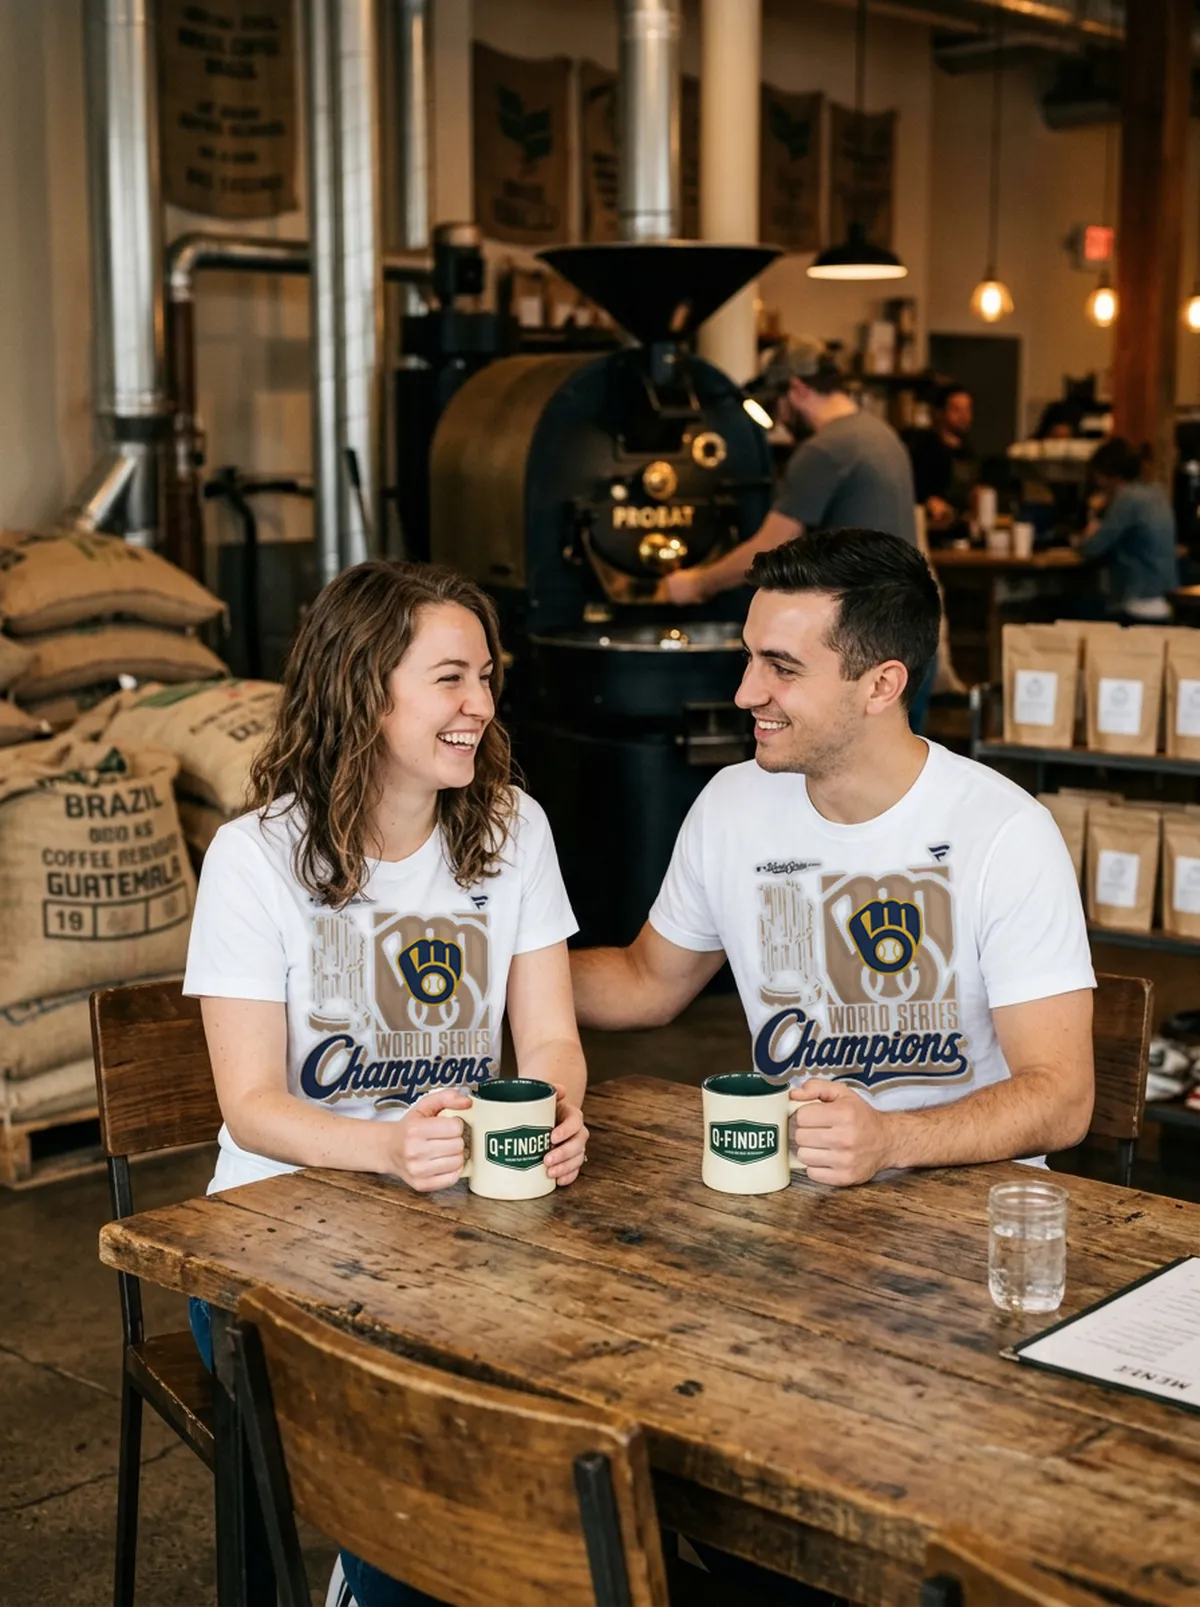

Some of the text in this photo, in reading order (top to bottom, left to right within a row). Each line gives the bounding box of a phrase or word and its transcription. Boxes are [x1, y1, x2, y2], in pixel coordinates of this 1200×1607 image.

[65, 785, 163, 819] BRAZIL
[42, 848, 113, 868] COFFEE
[55, 910, 84, 931] 19
[828, 1001, 959, 1033] WORLD SERIES
[376, 1030, 491, 1058] WORLD SERIES
[754, 1008, 968, 1086] Champions
[301, 1034, 494, 1103] Champions
